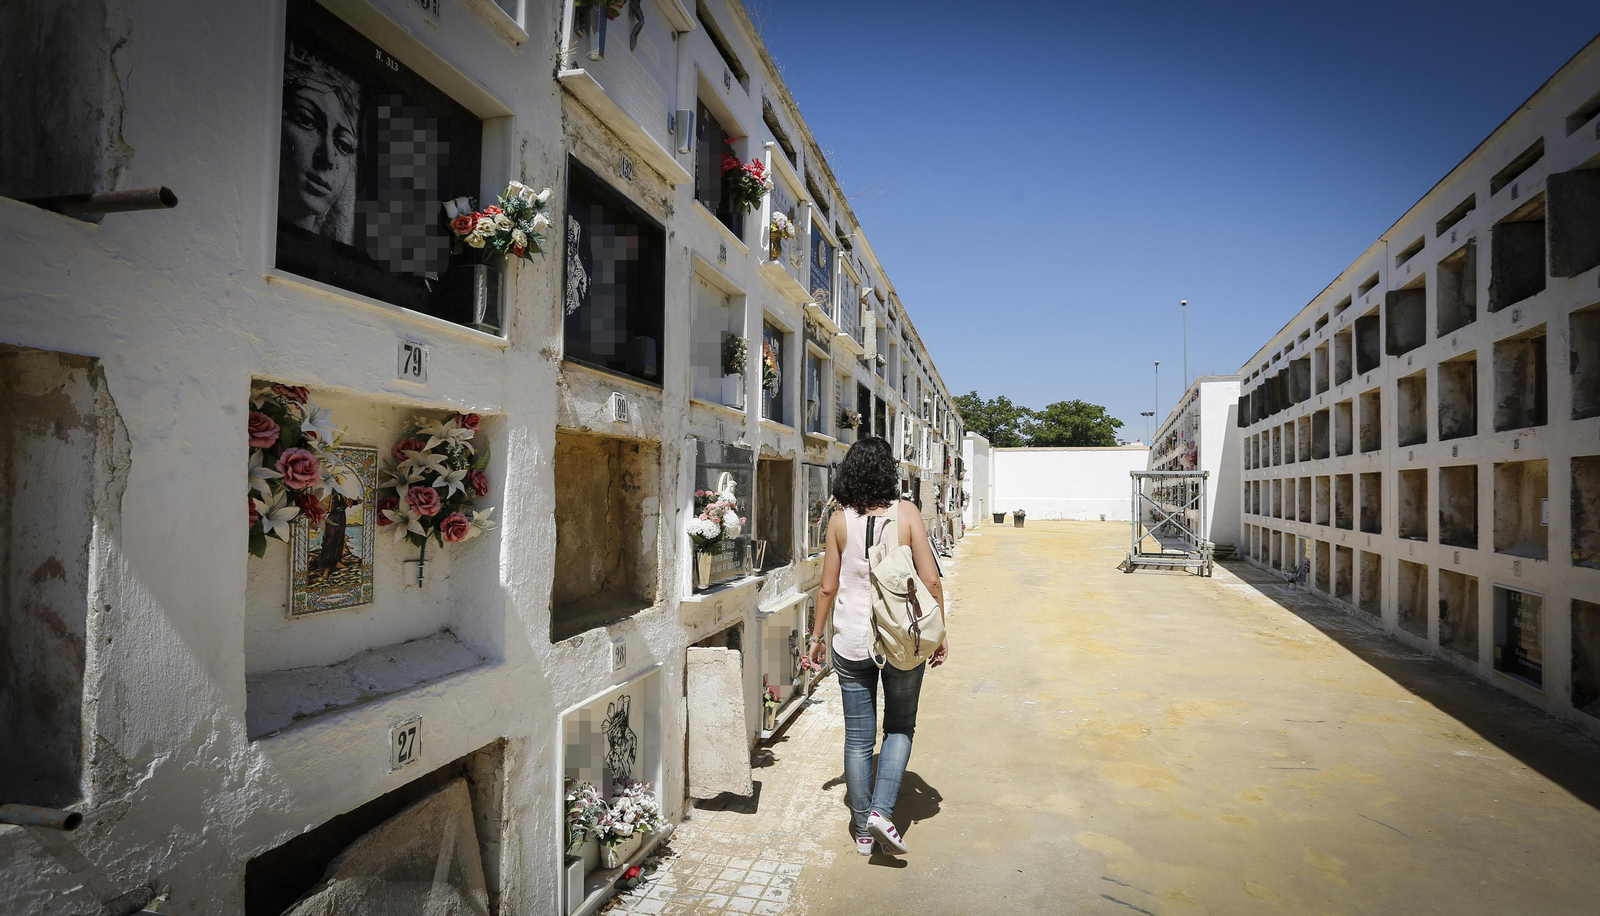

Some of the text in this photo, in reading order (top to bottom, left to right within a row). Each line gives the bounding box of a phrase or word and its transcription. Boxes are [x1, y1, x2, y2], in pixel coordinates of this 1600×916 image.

[375, 49, 399, 72] N. 313
[622, 157, 632, 182] 132
[403, 344, 422, 378] 79
[617, 397, 627, 420] 80
[615, 647, 625, 665] 28
[397, 726, 417, 763] 27
